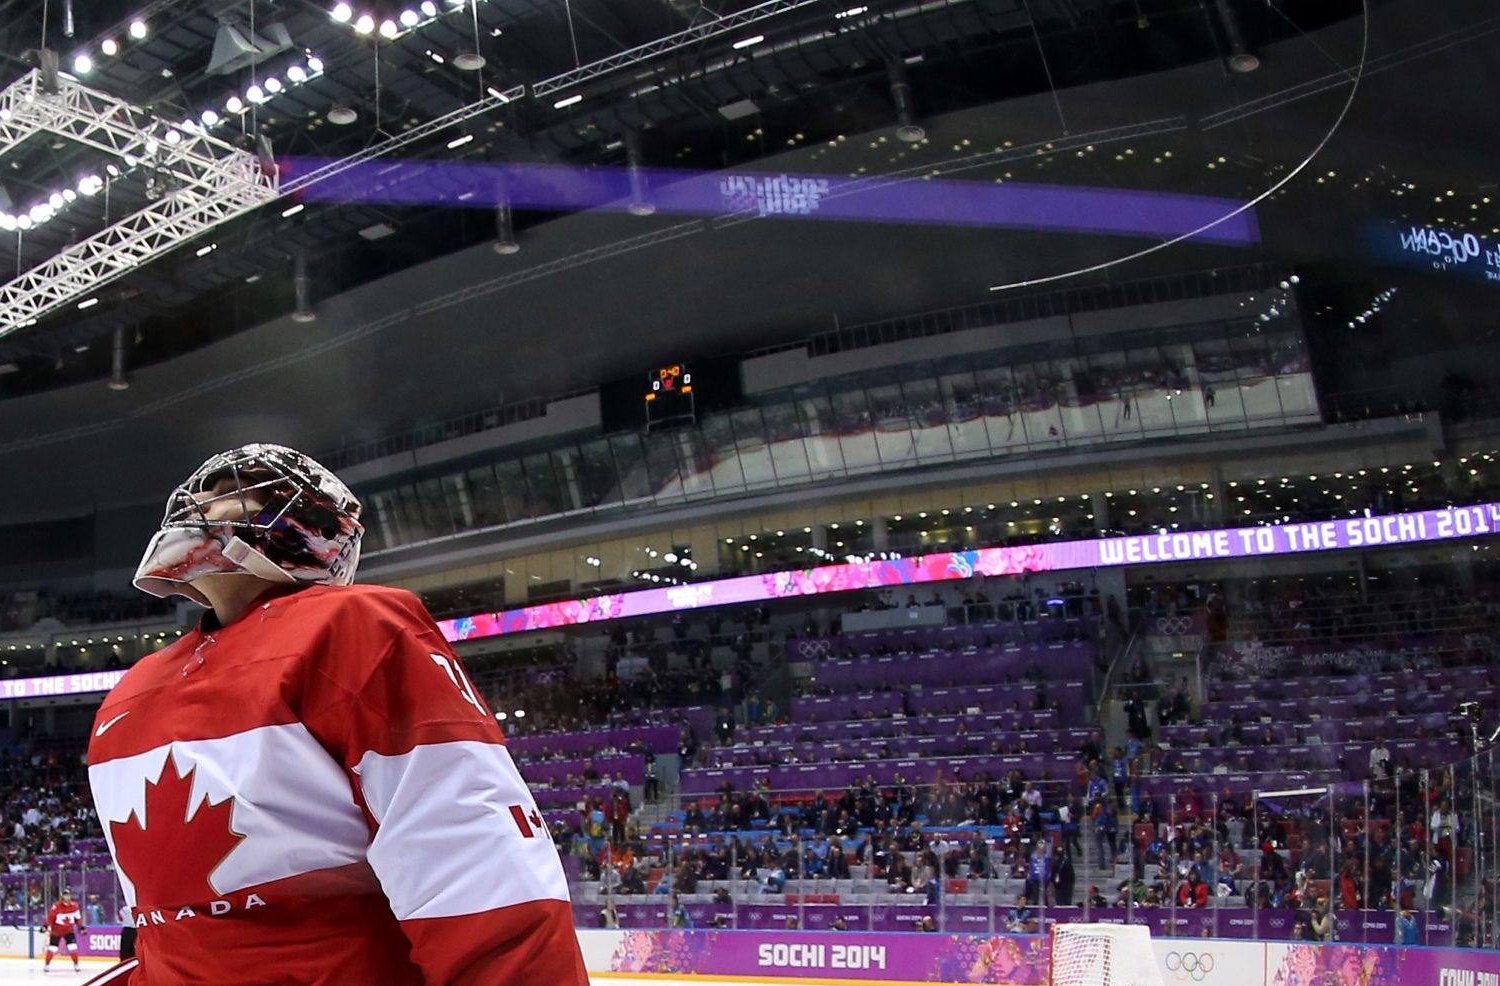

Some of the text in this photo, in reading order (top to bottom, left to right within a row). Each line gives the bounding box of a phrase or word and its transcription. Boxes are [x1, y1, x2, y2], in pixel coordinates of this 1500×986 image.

[1100, 532, 1230, 565] WELCOME
[1238, 528, 1275, 554] TO
[1284, 522, 1338, 551] THE
[1346, 514, 1427, 546] SOCHI
[3, 679, 26, 698] TO
[31, 676, 65, 695] THE
[135, 893, 268, 929] ANADA
[758, 943, 886, 969] SOCHI 2014
